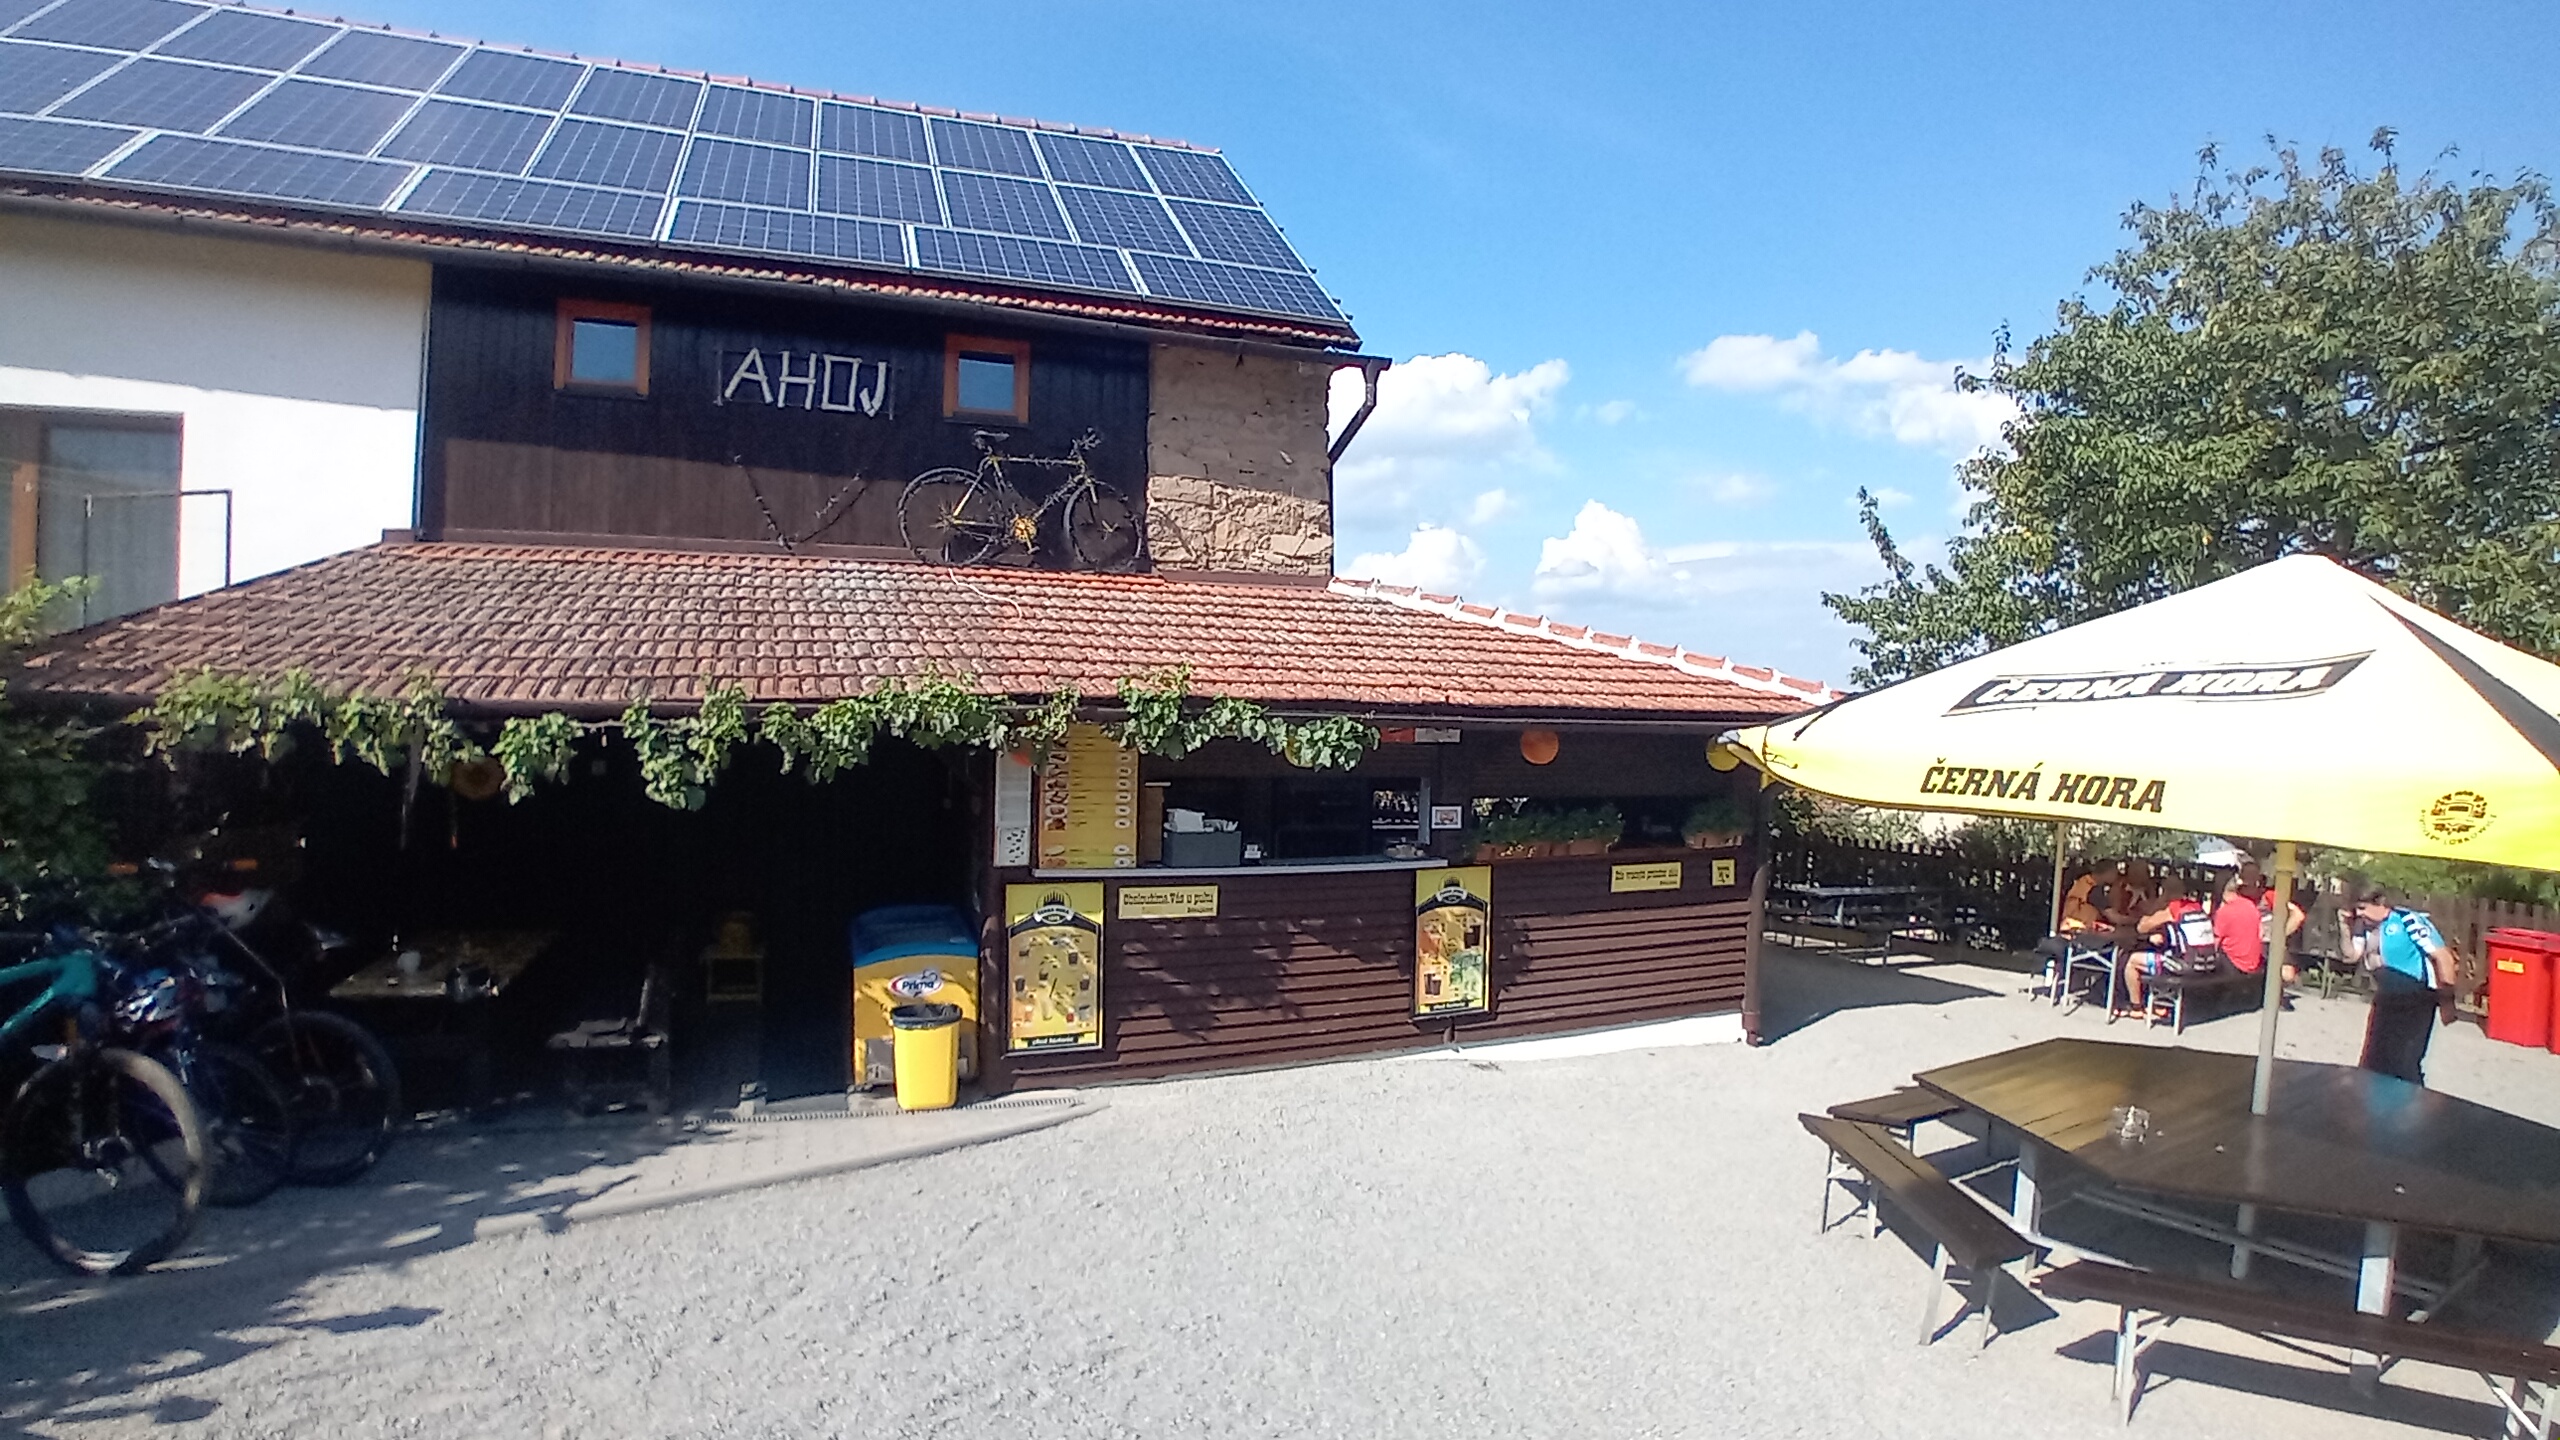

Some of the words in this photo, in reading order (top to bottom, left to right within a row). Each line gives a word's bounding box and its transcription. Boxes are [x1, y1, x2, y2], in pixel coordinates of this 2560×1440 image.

[724, 348, 888, 417] AHOJ
[2160, 665, 2333, 697] HORA
[1920, 757, 2043, 801] ČERNÁ
[2048, 773, 2167, 814] HORA
[902, 980, 935, 991] Prima
